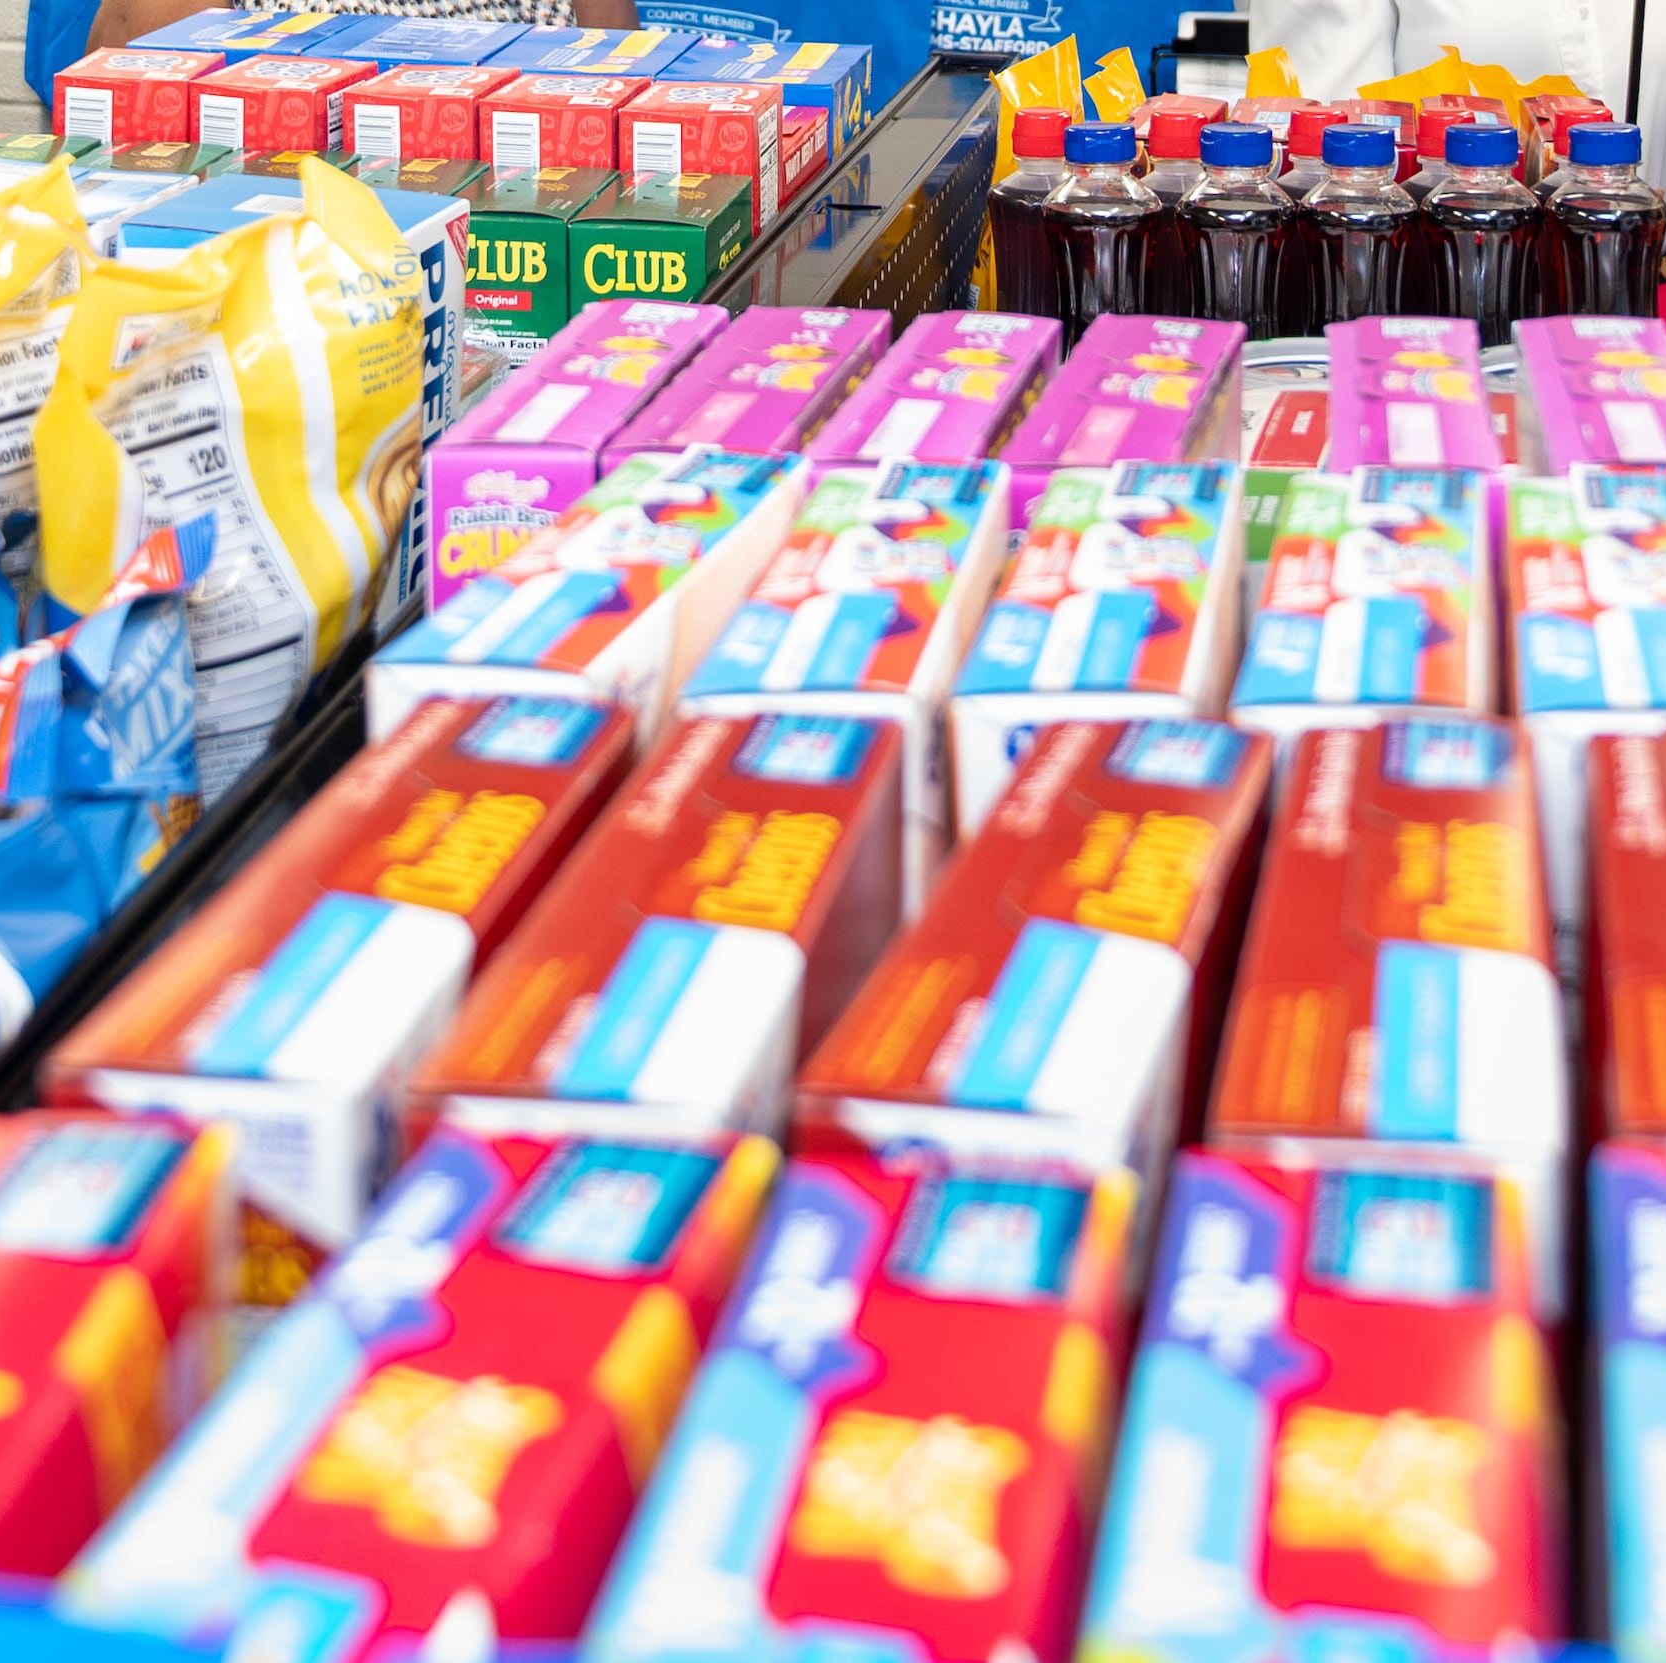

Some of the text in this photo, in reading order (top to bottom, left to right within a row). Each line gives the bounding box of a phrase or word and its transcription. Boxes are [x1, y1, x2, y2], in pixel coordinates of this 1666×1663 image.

[646, 8, 755, 31] COUNCIL MEMBER
[932, 9, 1024, 39] HAYLA
[584, 243, 688, 295] CLUB
[475, 293, 518, 307] Original
[510, 339, 545, 350] Facts
[164, 363, 209, 387] Facts
[188, 443, 228, 477] 120
